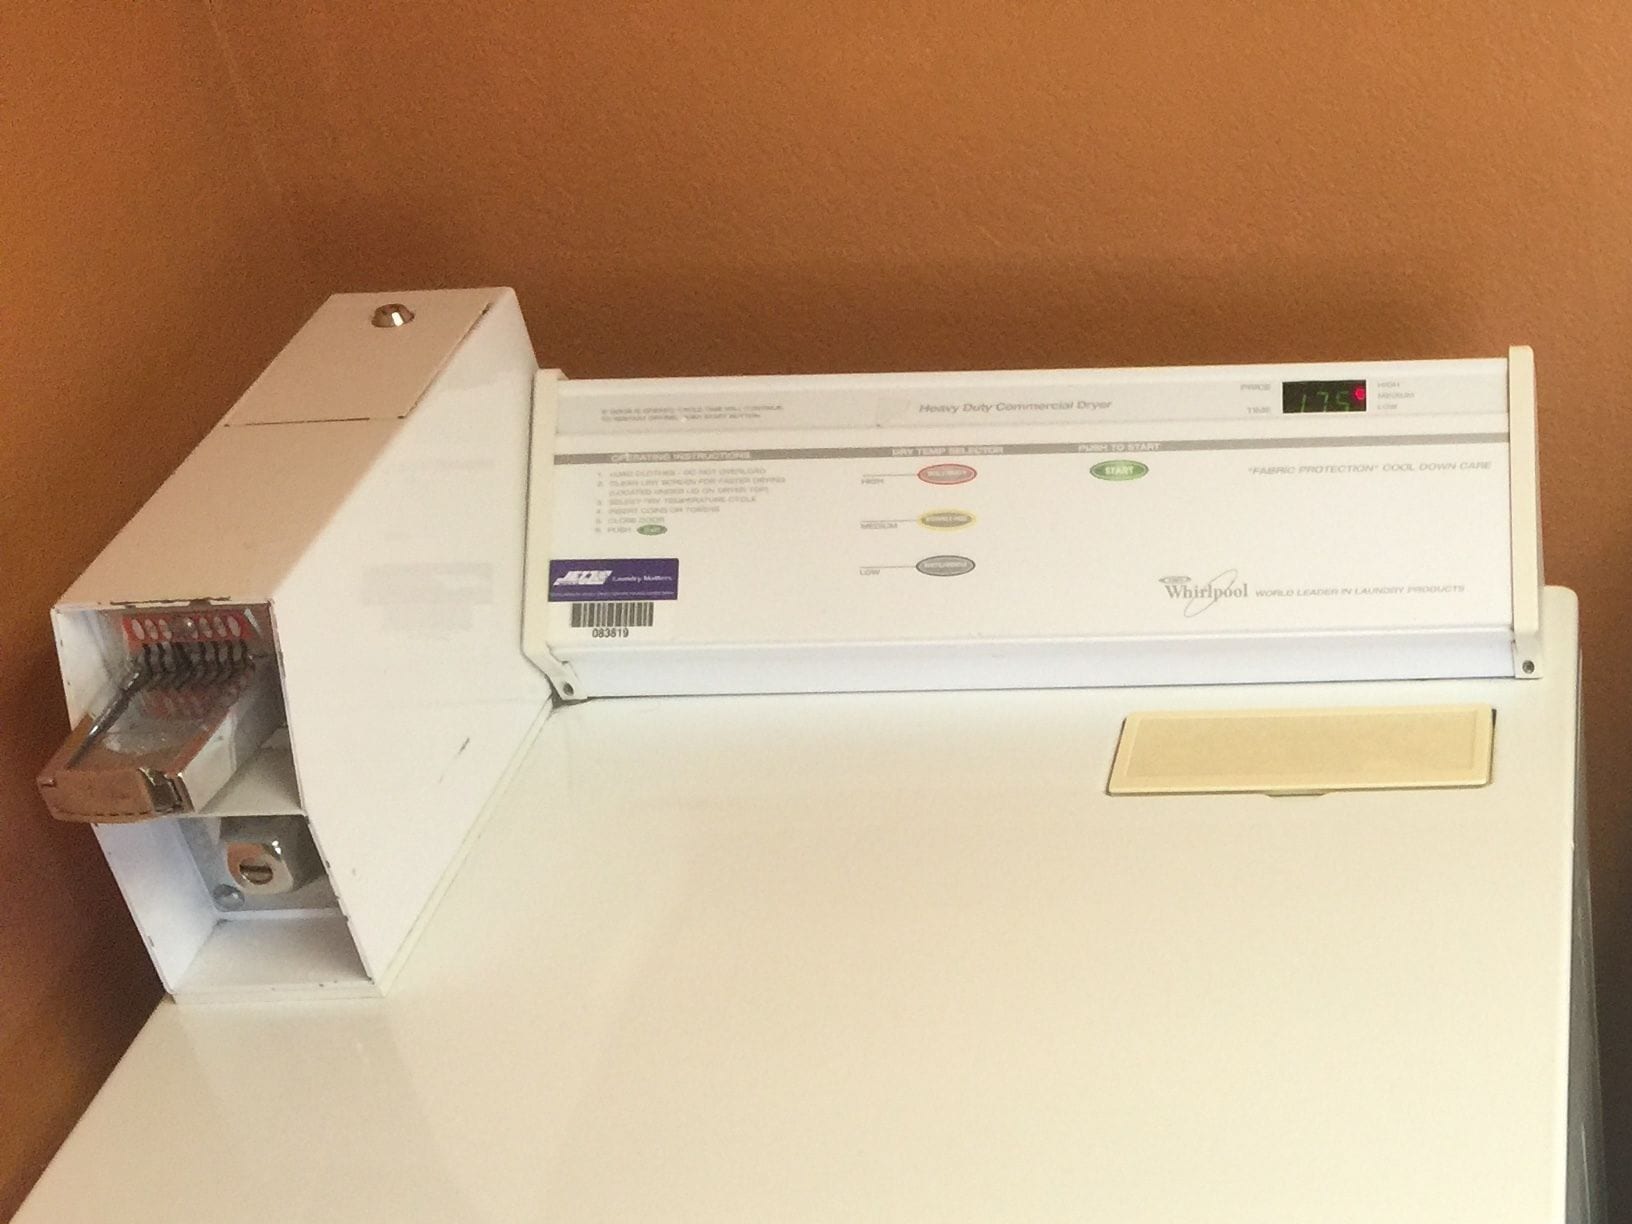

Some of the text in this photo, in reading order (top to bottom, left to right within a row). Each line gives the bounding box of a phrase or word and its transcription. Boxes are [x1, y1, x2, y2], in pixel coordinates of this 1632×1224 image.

[919, 400, 1112, 414] Heavy Duty Commercial Dryer
[1105, 465, 1134, 475] START
[1382, 463, 1414, 473] COOL
[1419, 462, 1457, 472] DOWN
[1460, 461, 1492, 470] CARE
[1164, 583, 1249, 602] Whirlpool
[1255, 589, 1295, 598] WORLD
